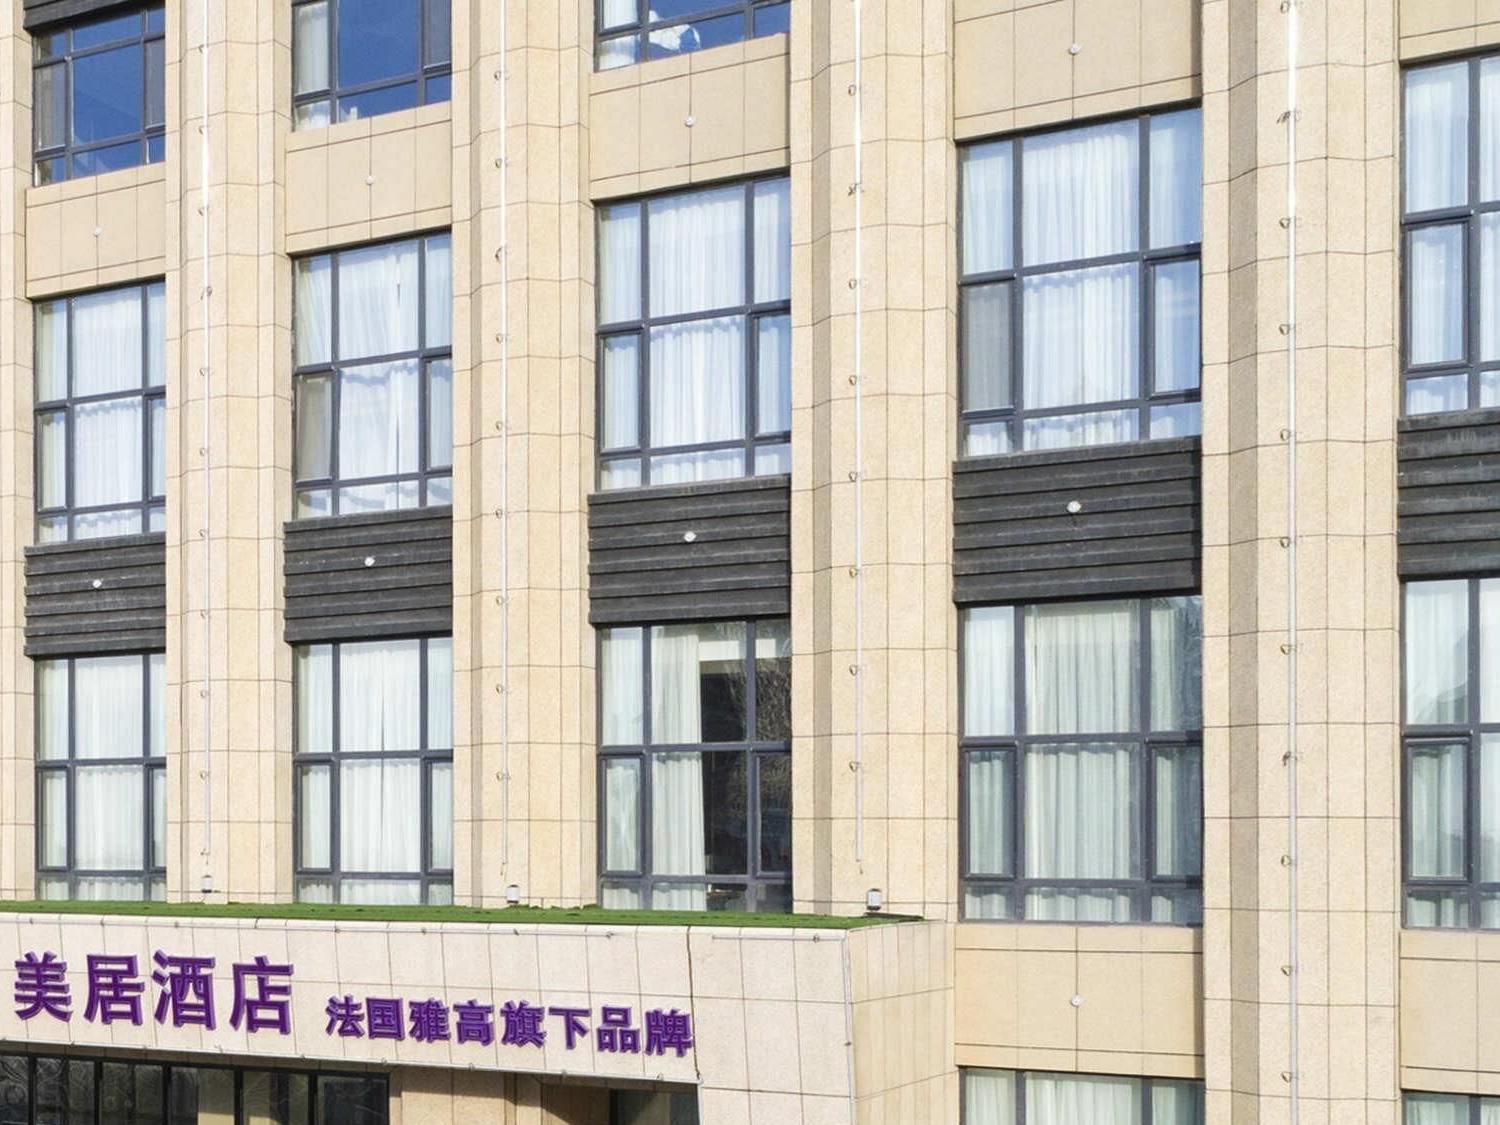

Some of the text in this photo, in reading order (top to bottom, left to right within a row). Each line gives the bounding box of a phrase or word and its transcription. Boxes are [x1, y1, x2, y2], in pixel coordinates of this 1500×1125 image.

[13, 951, 295, 1034] 美居酒店
[326, 995, 694, 1058] 法国雅高旗下品牌
